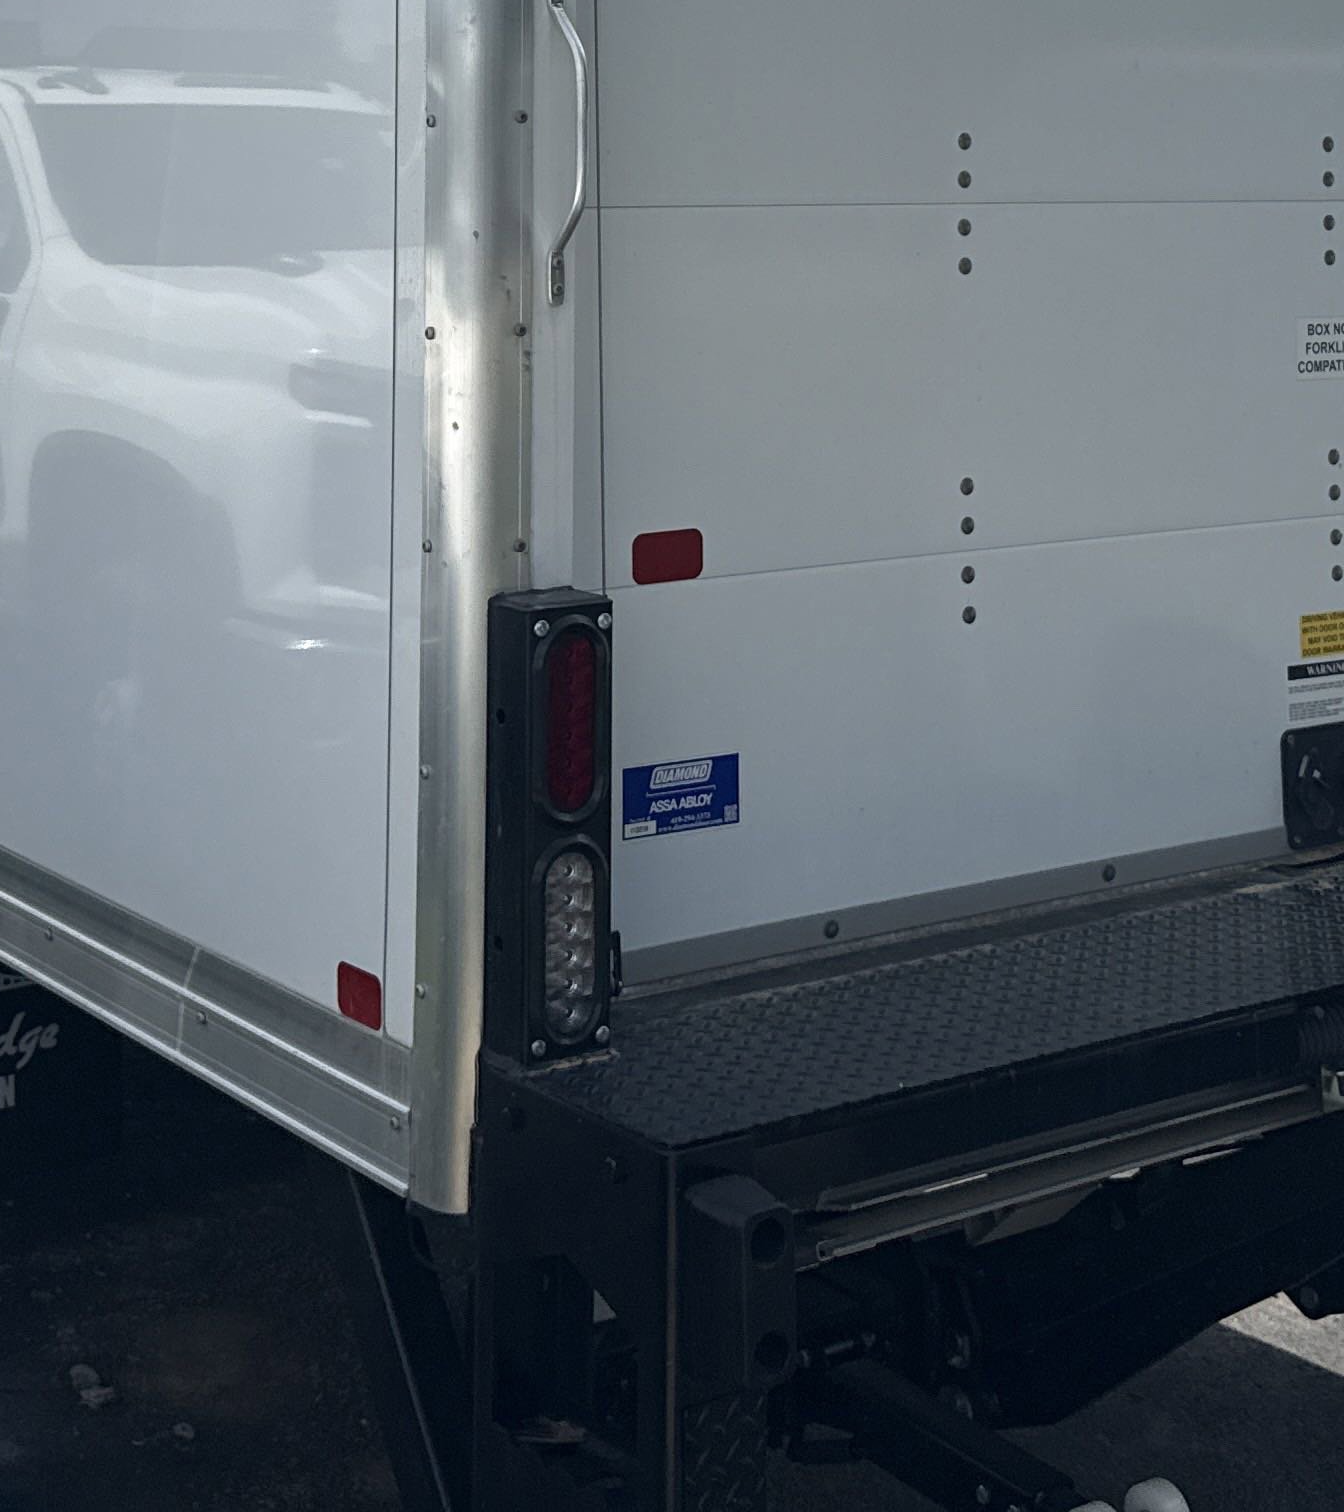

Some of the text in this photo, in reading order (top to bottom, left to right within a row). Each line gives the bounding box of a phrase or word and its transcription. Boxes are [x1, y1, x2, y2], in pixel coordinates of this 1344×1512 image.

[1307, 323, 1330, 336] BOX
[1319, 623, 1337, 632] DOOR
[1307, 635, 1321, 645] MAY
[1323, 633, 1338, 643] VOID
[1302, 646, 1321, 657] DOOR
[655, 763, 708, 785] DIAMOND
[649, 792, 713, 814] ASSA ABLOY
